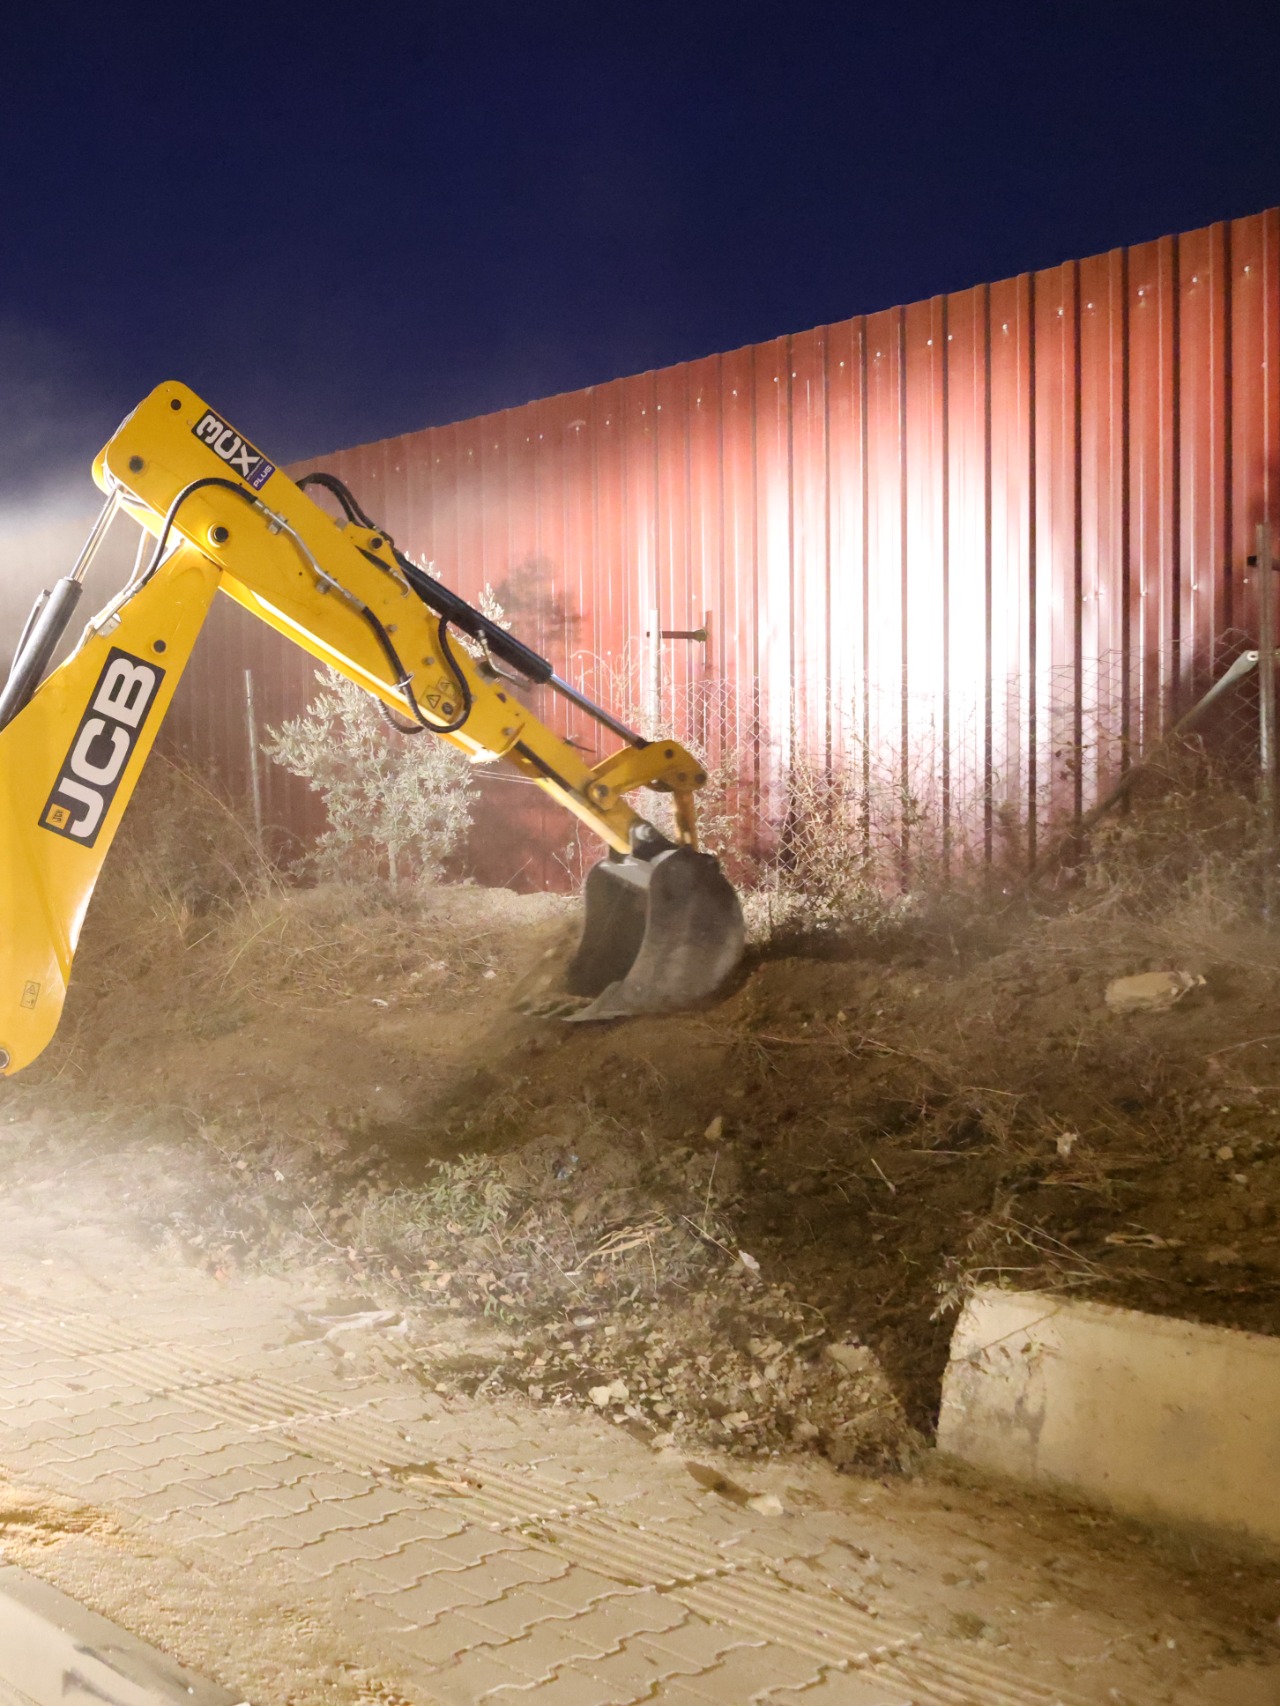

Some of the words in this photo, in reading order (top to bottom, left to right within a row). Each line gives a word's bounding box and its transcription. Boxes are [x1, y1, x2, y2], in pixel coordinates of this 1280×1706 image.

[196, 414, 261, 478] 3CX
[253, 465, 273, 487] PLUS
[58, 658, 156, 838] JCB
